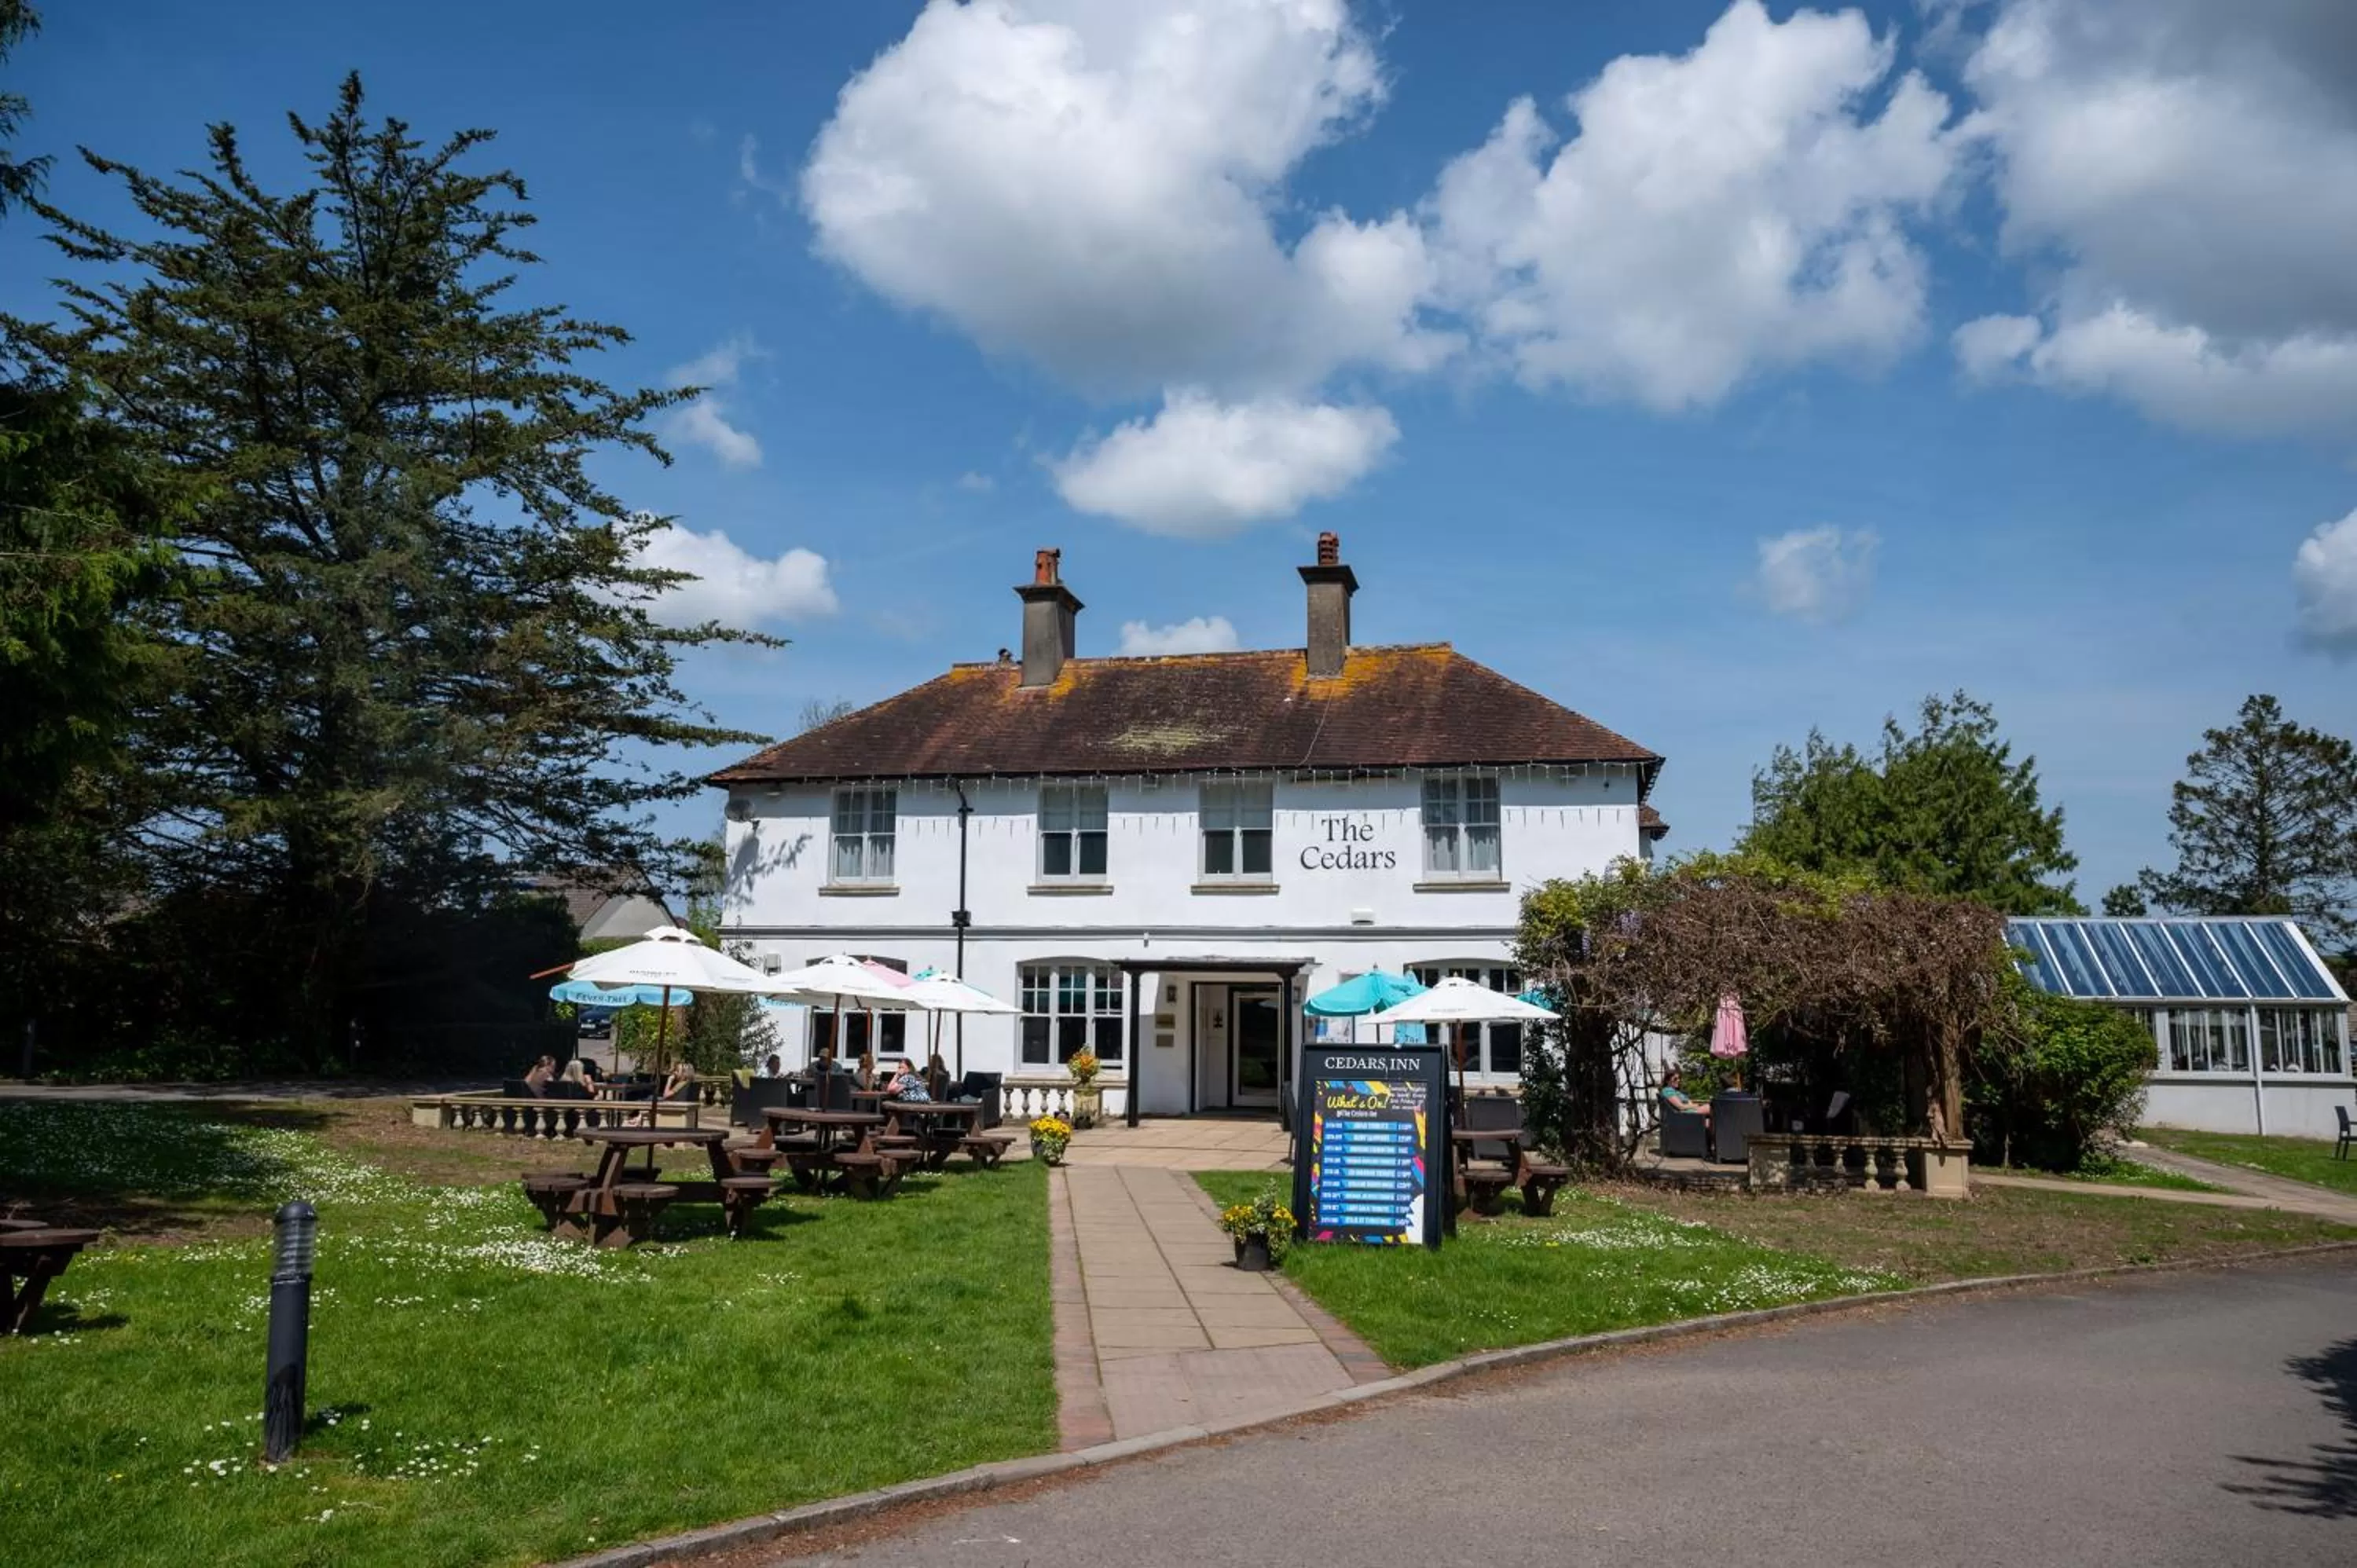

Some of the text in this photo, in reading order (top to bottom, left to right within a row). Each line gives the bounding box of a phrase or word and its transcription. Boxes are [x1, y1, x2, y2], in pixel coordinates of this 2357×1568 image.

[1321, 817, 1374, 841] The
[1300, 844, 1396, 870] Cedars
[1325, 1057, 1420, 1071] CEDARS INN
